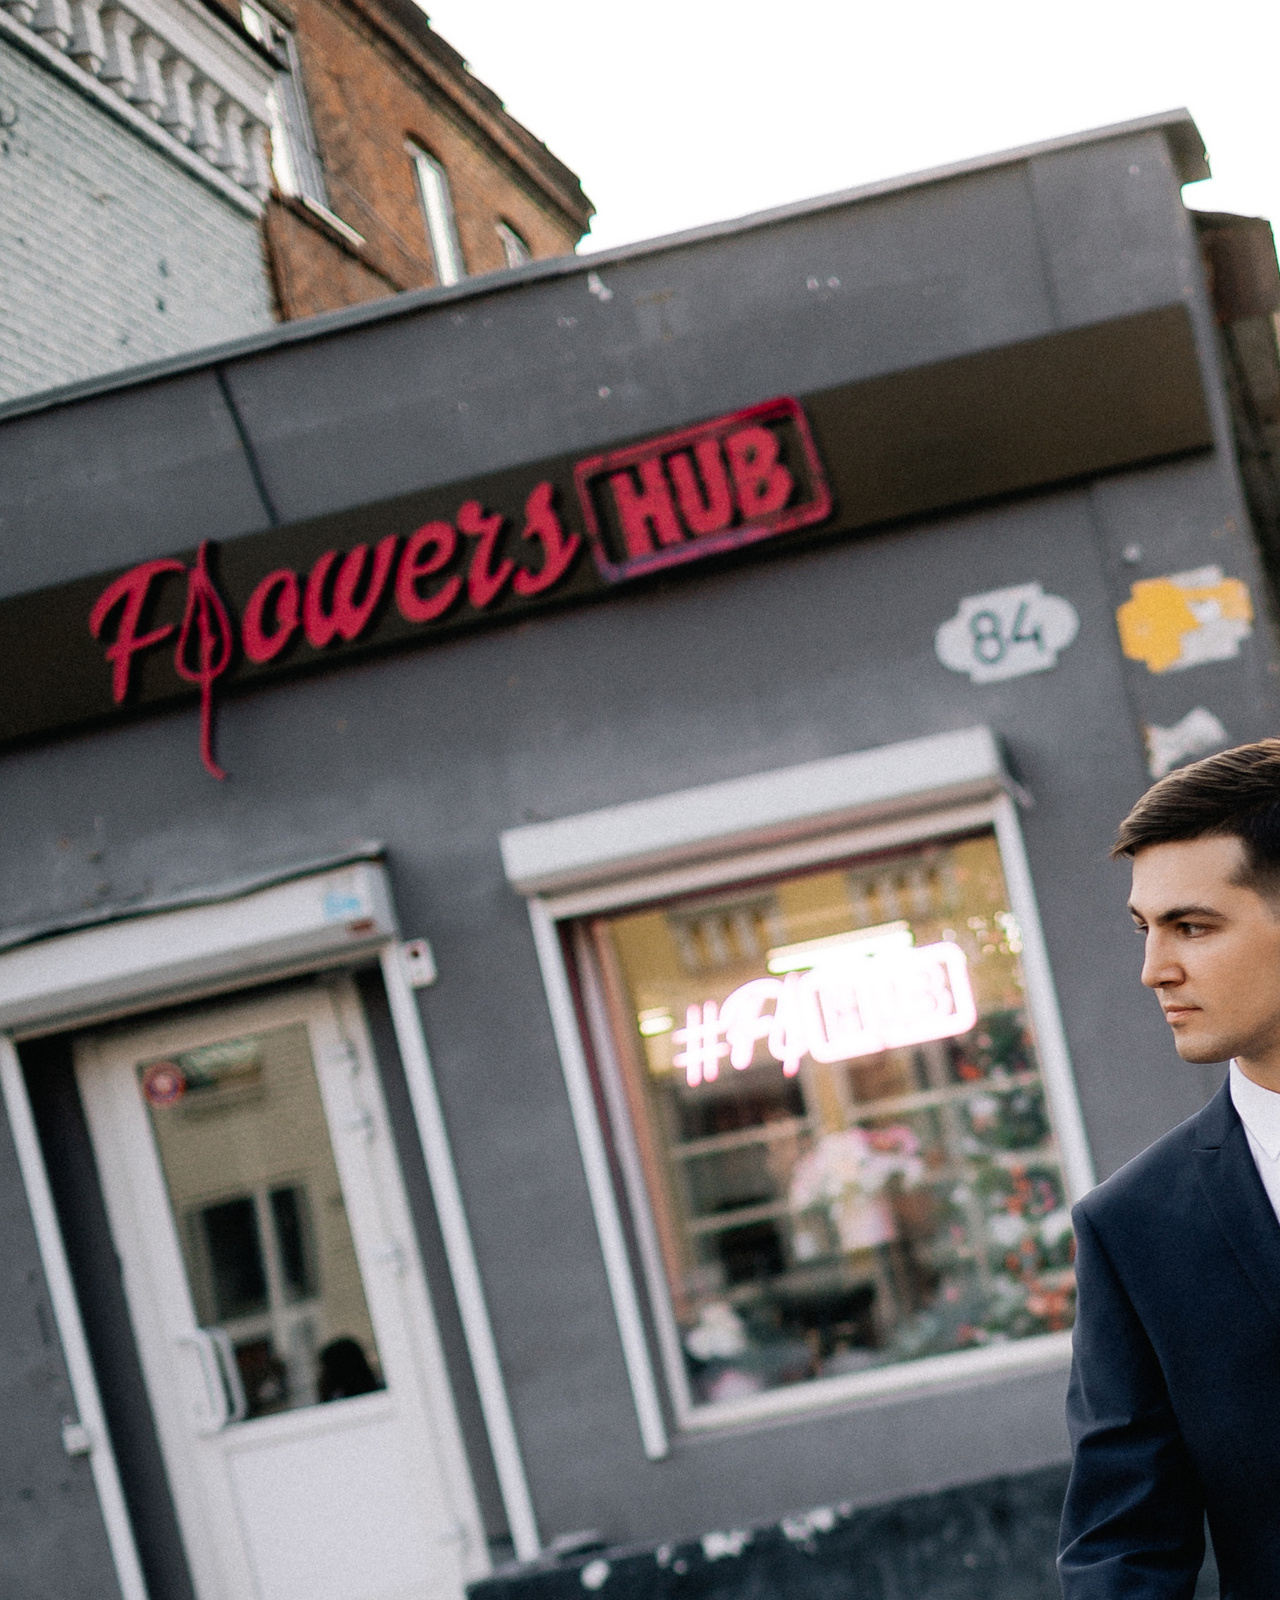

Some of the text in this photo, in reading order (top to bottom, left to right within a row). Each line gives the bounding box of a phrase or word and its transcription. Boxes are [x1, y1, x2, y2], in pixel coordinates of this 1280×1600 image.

[88, 425, 797, 780] Flowers HUB
[969, 601, 1046, 665] 84
